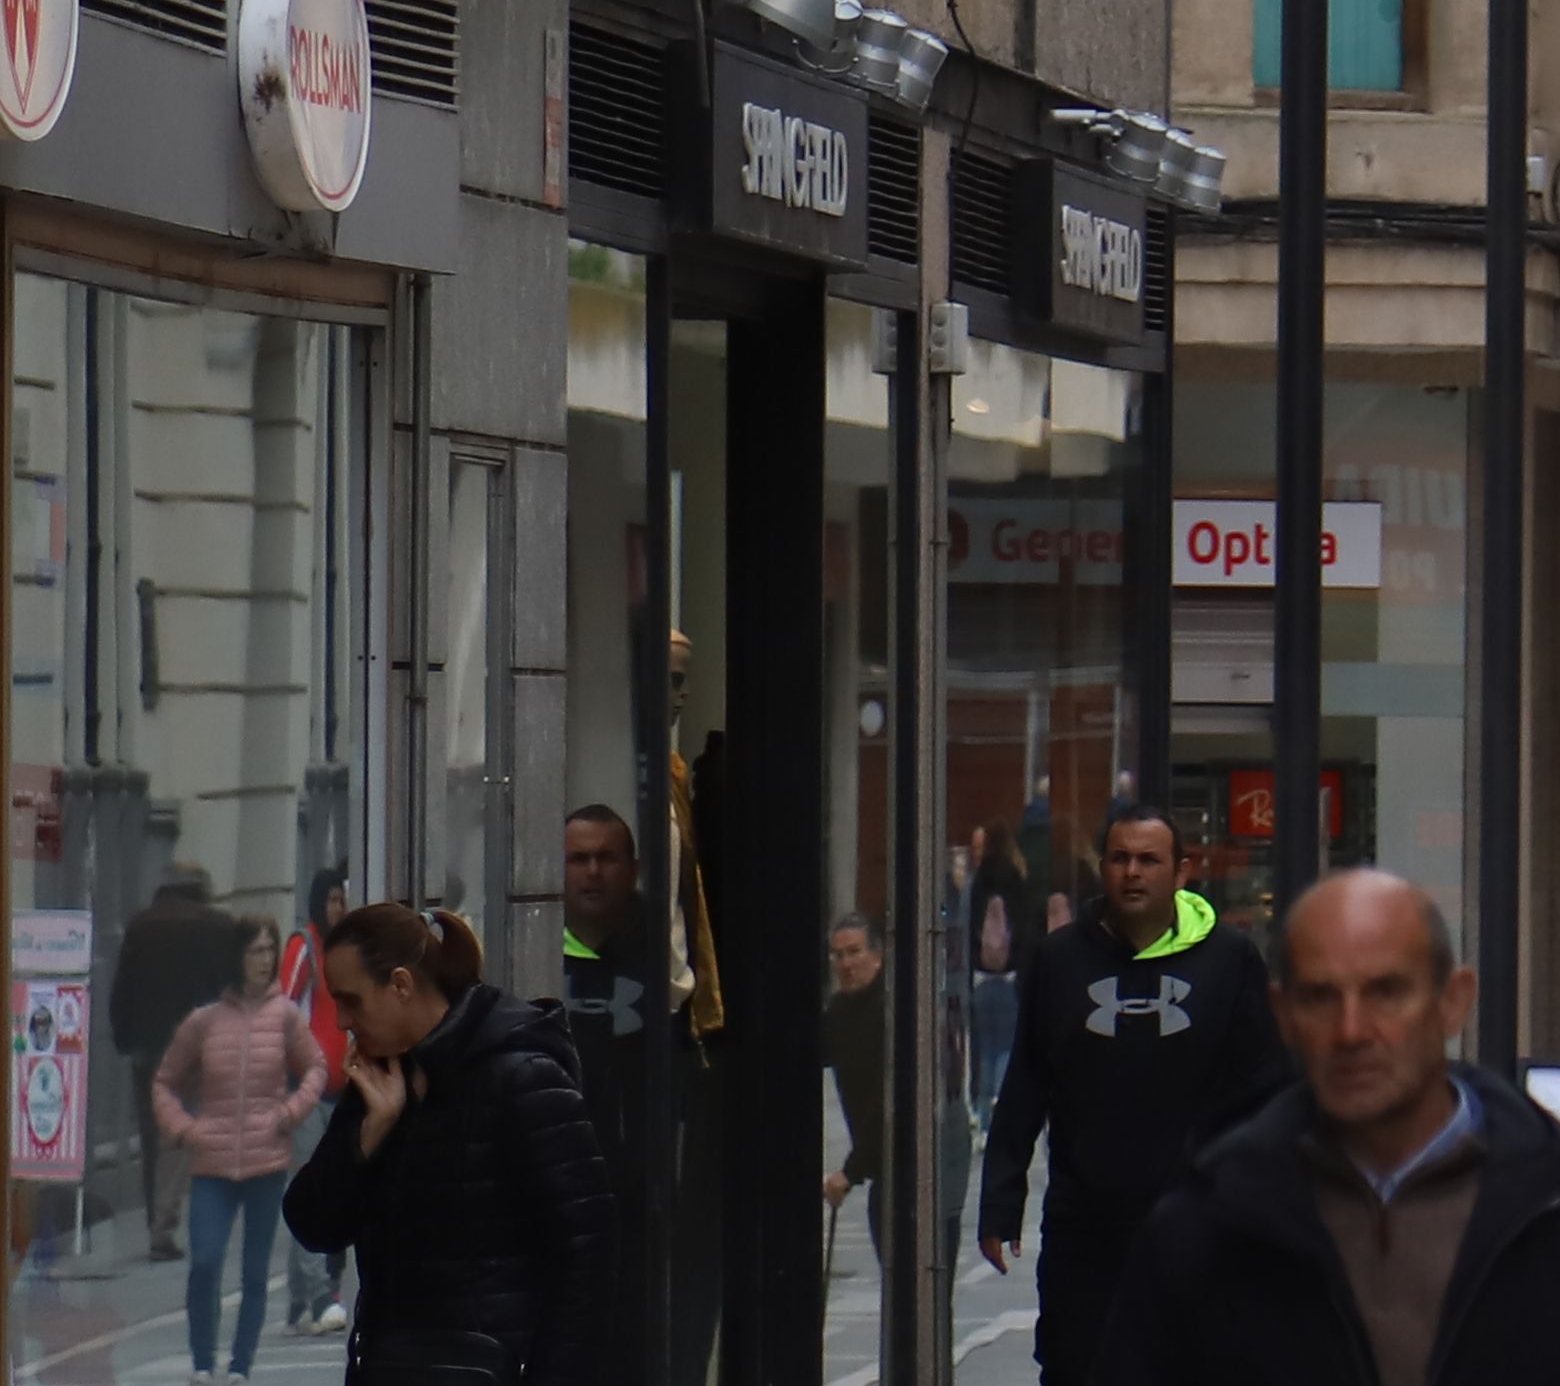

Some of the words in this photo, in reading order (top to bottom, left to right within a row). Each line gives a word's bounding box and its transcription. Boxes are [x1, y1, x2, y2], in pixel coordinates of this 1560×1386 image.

[290, 24, 362, 114] ROLLSMAN
[742, 101, 848, 217] SPRINGFIELD
[1061, 203, 1142, 303] SPRINGFIELD
[991, 518, 1125, 564] Gener
[1187, 521, 1338, 577] Opta
